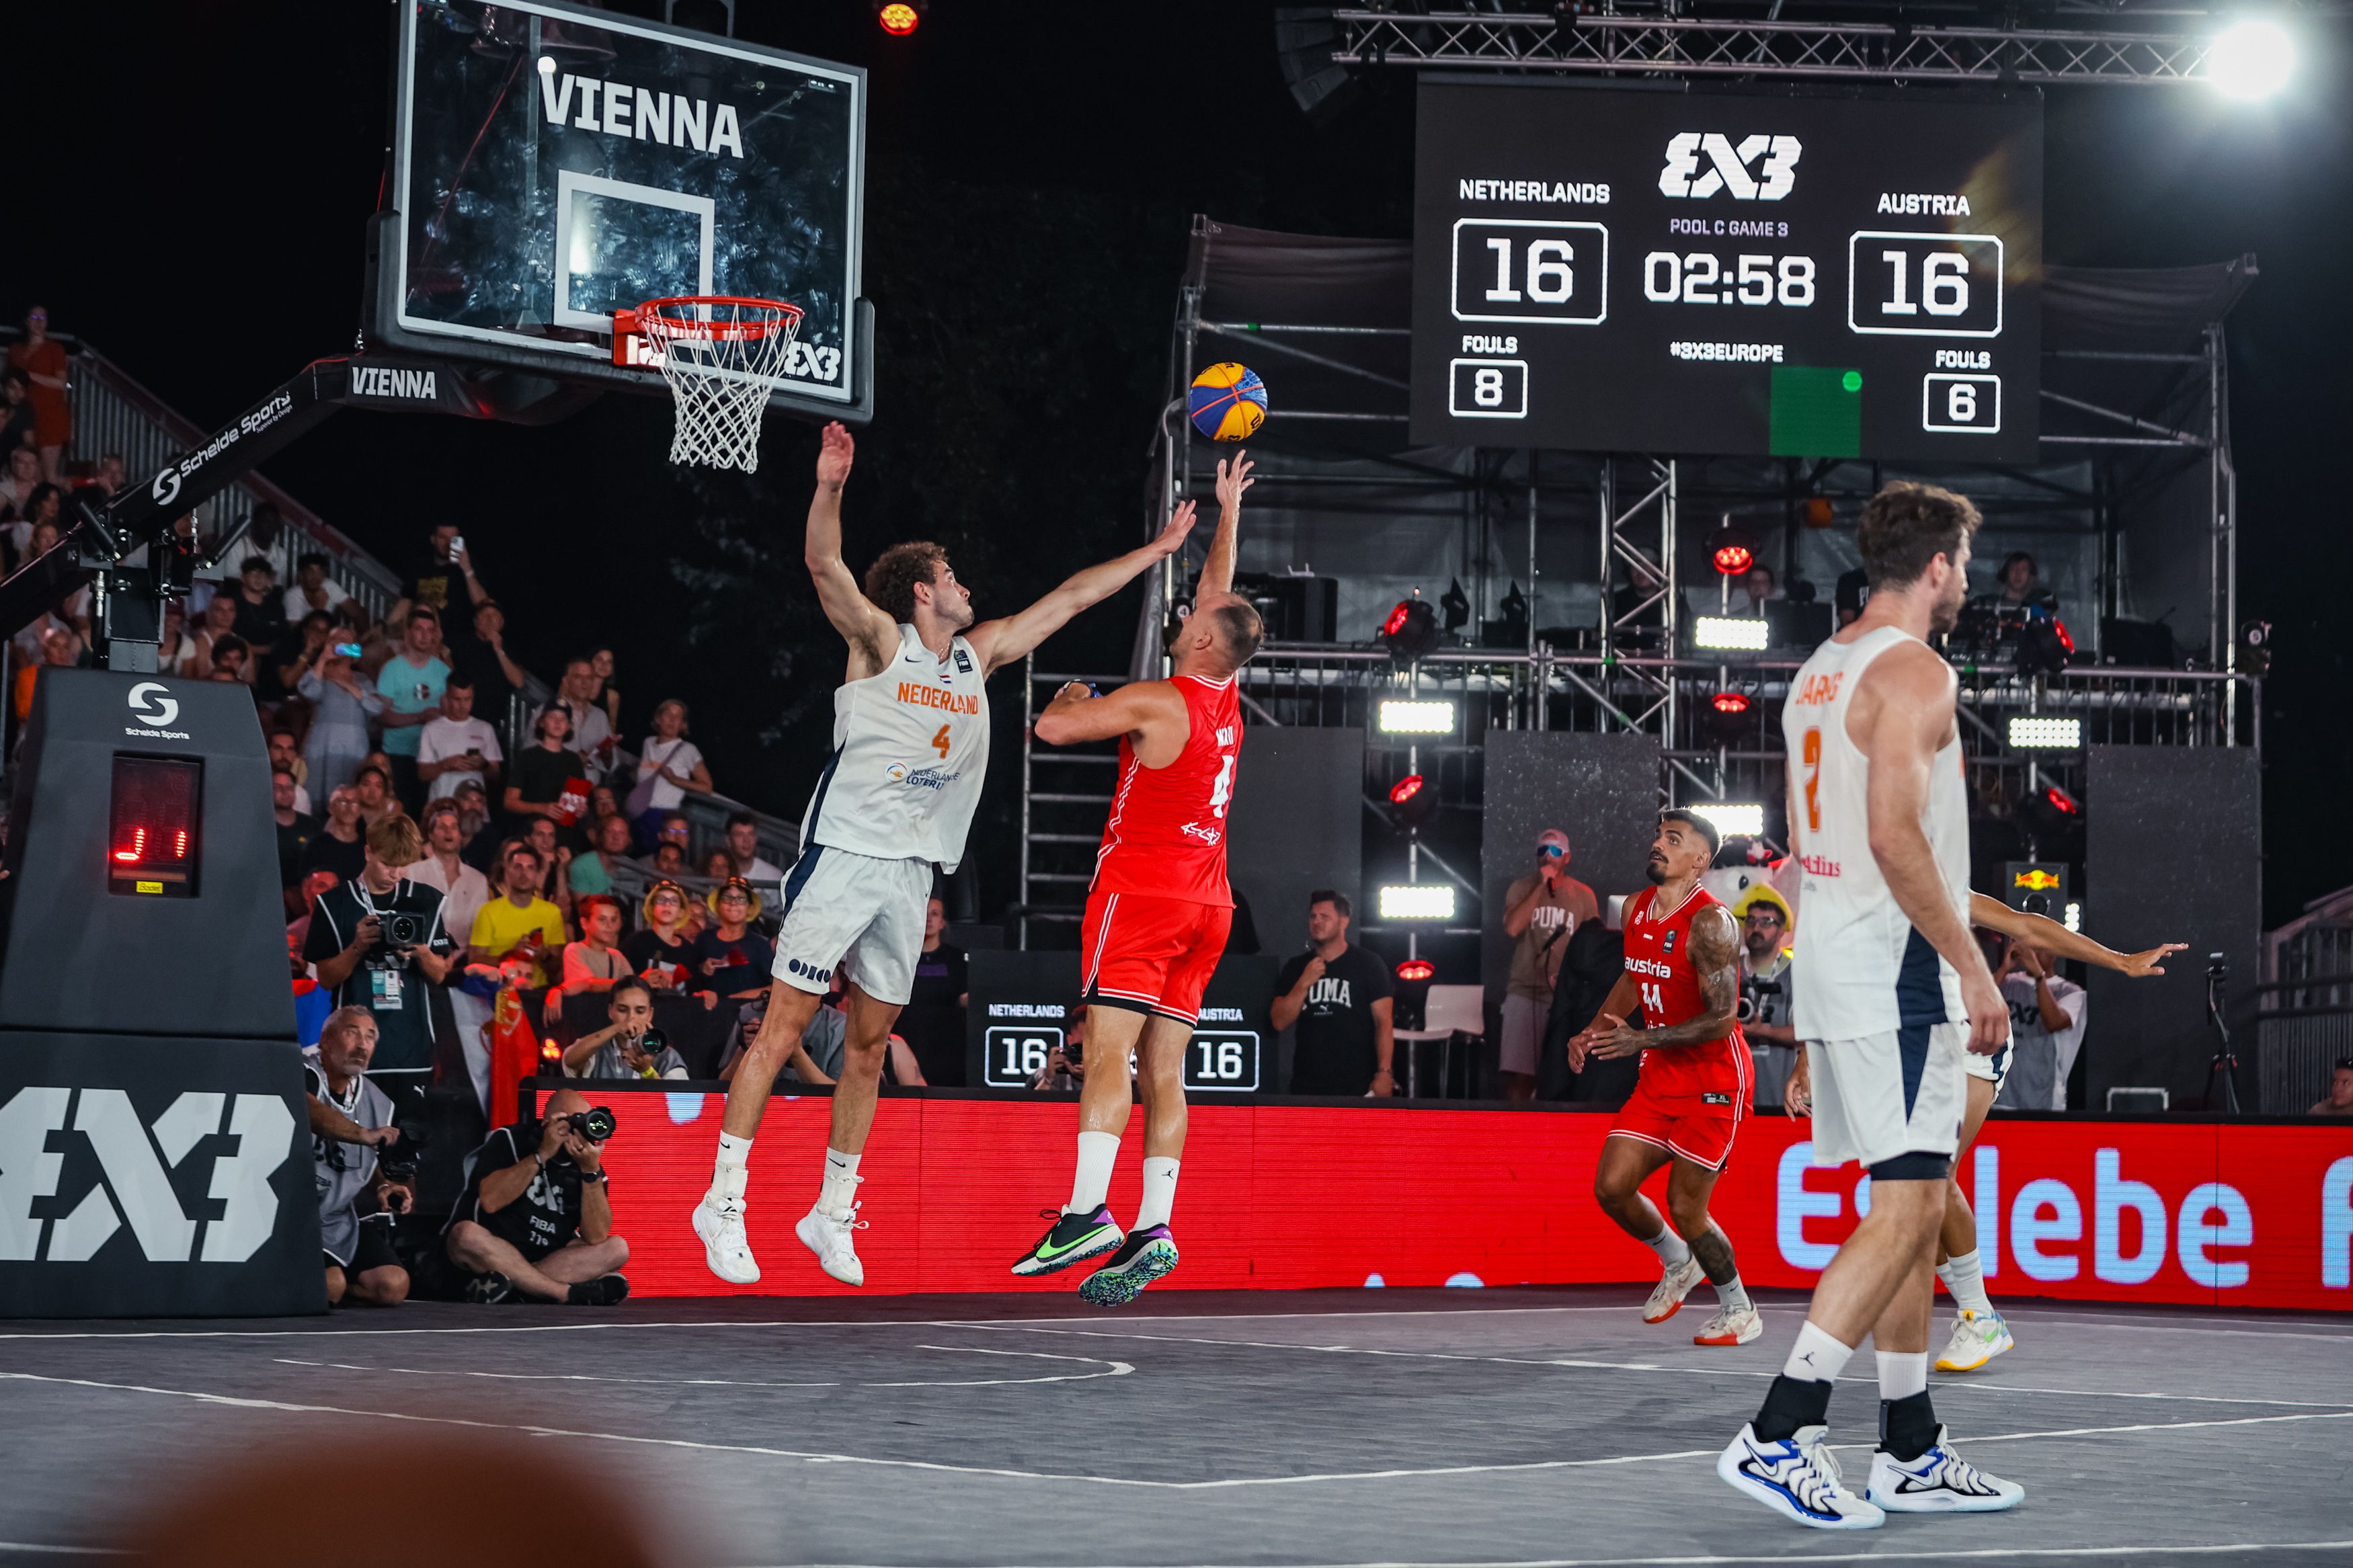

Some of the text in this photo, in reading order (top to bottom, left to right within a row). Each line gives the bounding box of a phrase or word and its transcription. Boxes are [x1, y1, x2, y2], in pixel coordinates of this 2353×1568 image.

[539, 71, 744, 159] VIENNA
[1460, 178, 1611, 204] NETHERLANDS
[1877, 193, 1970, 217] AUSTRIA
[1670, 218, 1789, 237] POOL C GAME 3
[1484, 237, 1574, 304] 16
[1644, 251, 1816, 307] 02:58
[1881, 250, 1970, 317] 16
[1462, 335, 1519, 355] FOULS
[1670, 341, 1784, 364] #3X3EUROPE
[1935, 349, 1991, 370] FOULS
[352, 366, 437, 399] VIENNA
[1474, 368, 1503, 407] 8
[1947, 382, 1977, 422] 6
[180, 390, 290, 478] Schelde Sports
[898, 682, 978, 715] NEDERLAND
[124, 727, 190, 740] Schelde Sports
[931, 723, 951, 759] 4
[1209, 755, 1234, 819] 4
[1802, 726, 1821, 831] 2
[1531, 906, 1574, 936] PUMA
[1624, 956, 1671, 979] austria
[988, 1003, 1065, 1018] NETHERLANDS
[1302, 978, 1352, 1010] UMA
[1197, 1007, 1243, 1021] AUSTRIA
[1001, 1038, 1047, 1075] 16
[1197, 1041, 1242, 1079] 16
[530, 1214, 557, 1235] FIBA
[1975, 1145, 2254, 1288] lebe
